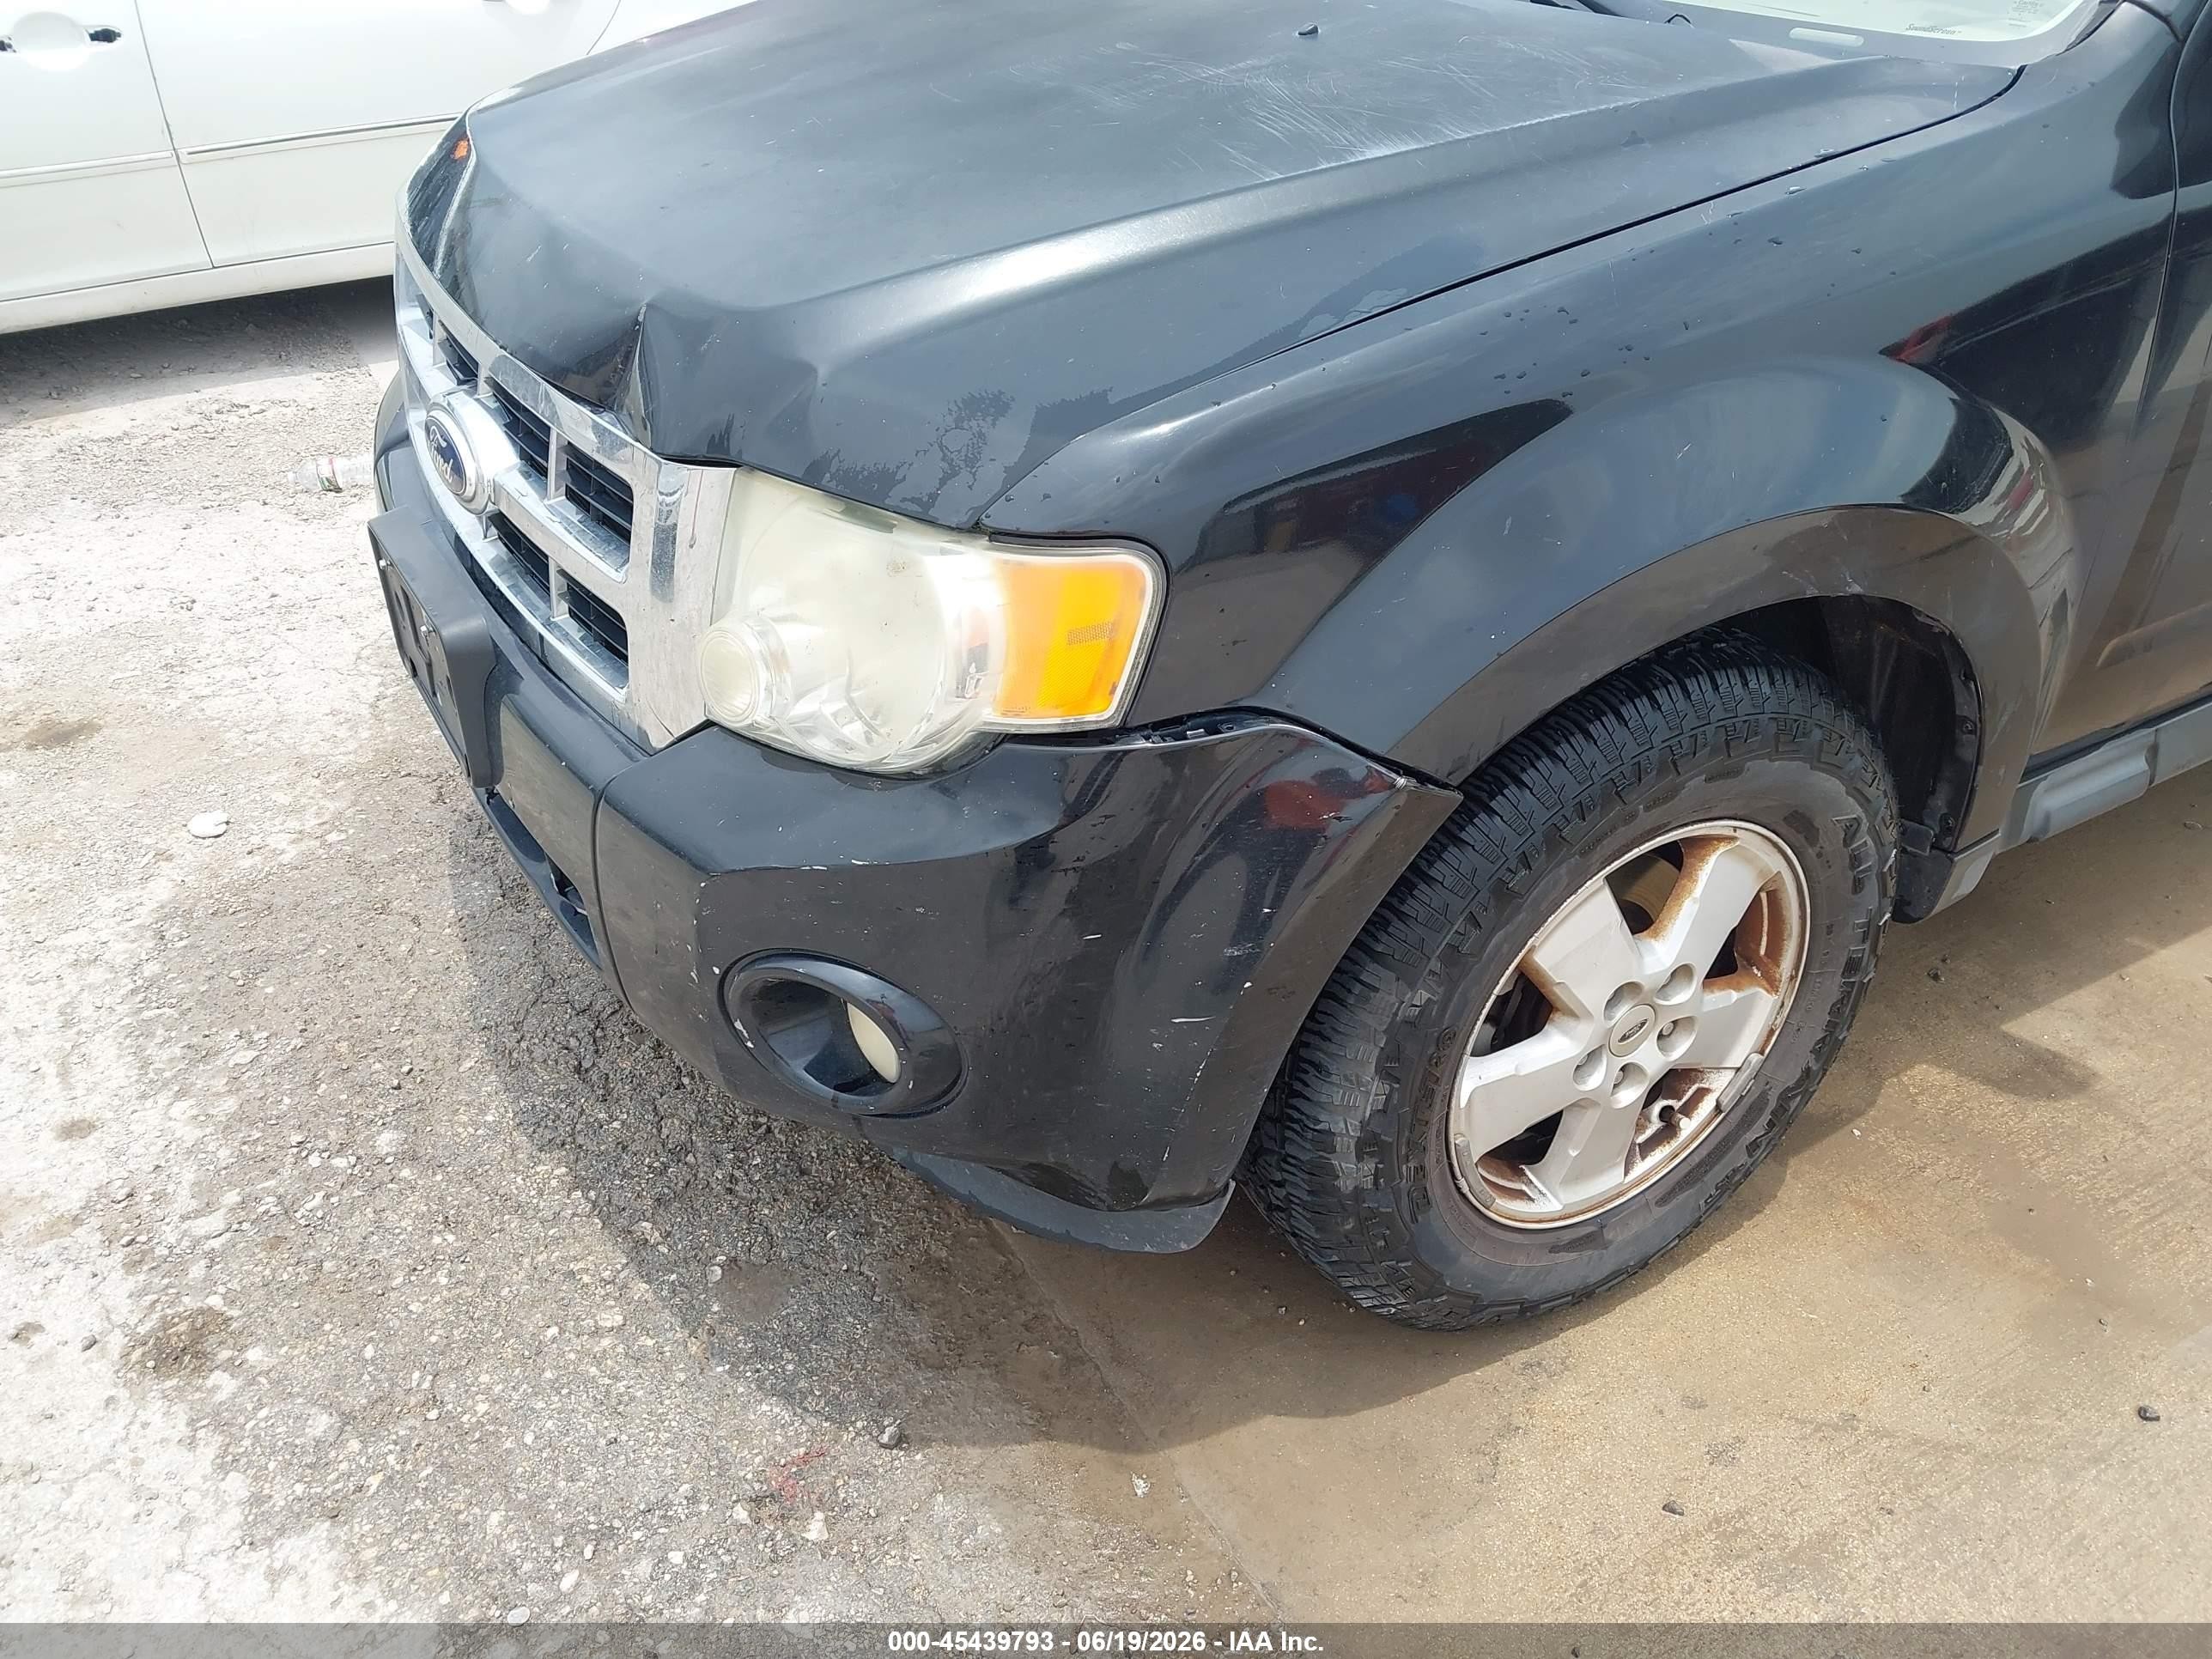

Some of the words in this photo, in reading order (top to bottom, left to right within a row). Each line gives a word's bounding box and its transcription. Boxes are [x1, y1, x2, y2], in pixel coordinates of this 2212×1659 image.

[428, 425, 453, 483] Ford
[1832, 815, 1873, 896] ALL
[1745, 906, 1874, 1160] TERRAIN
[1403, 1025, 1458, 1224] DEXTERO
